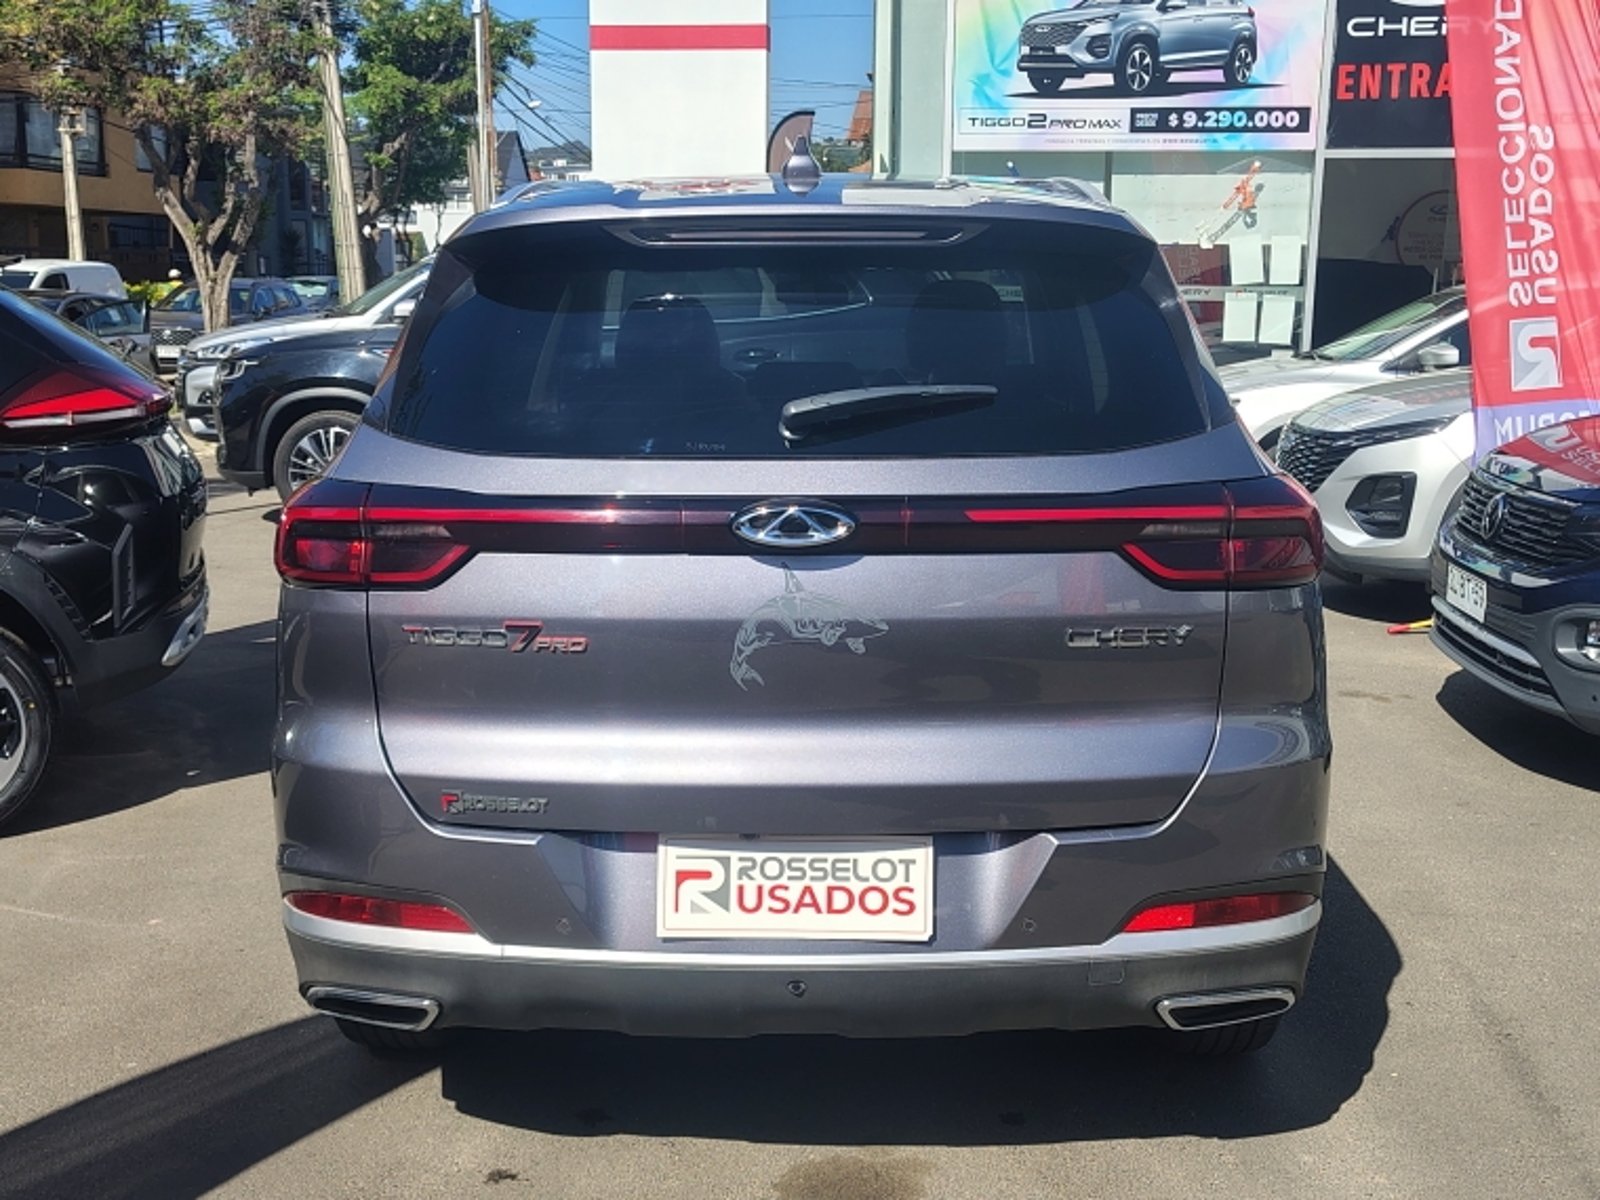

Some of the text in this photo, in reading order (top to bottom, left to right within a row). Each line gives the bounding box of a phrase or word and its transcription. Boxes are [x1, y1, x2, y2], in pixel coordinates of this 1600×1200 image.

[1066, 624, 1192, 648] CHERY
[737, 856, 917, 883] ROSSELOT
[737, 884, 917, 916] USADOS
